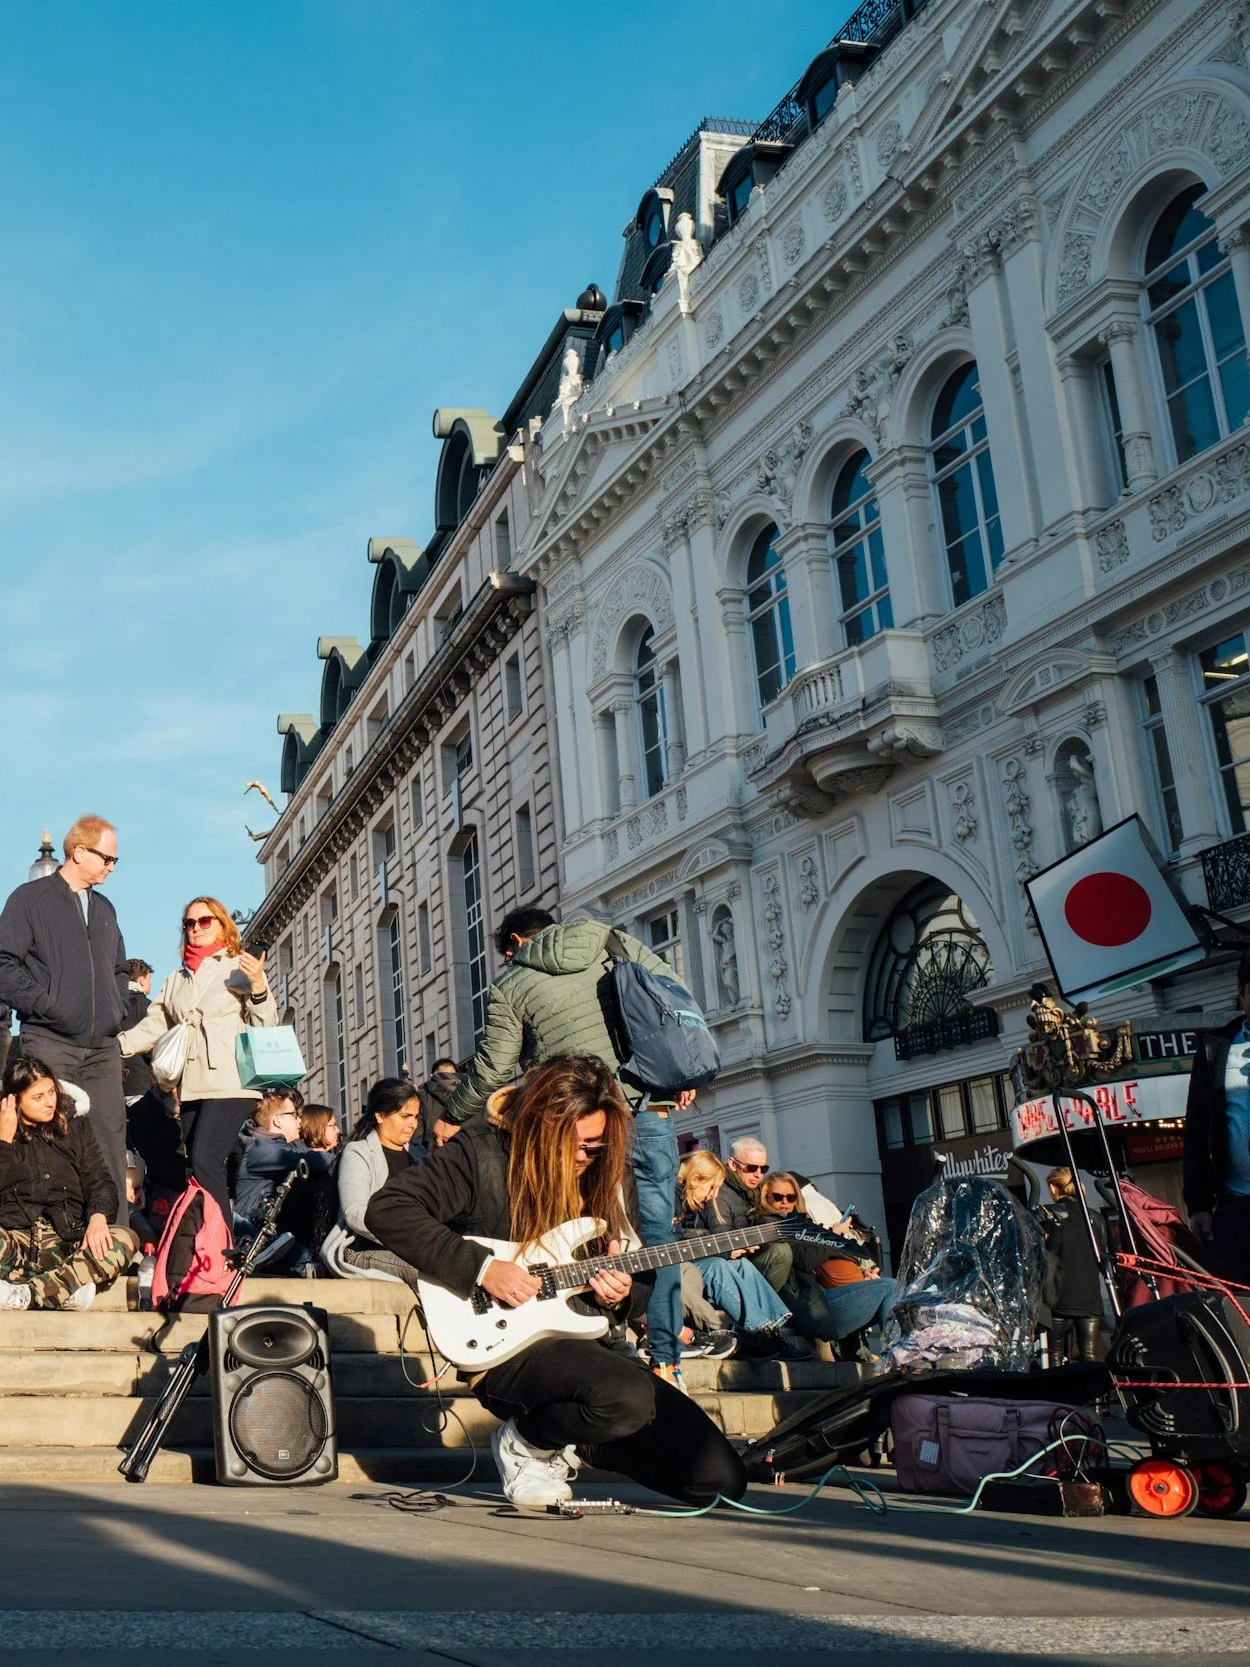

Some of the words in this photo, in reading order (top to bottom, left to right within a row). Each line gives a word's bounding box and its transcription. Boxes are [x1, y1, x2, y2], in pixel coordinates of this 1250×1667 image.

[1139, 1032, 1198, 1058] THE
[1154, 1142, 1179, 1151] BELIEVE
[934, 1145, 1011, 1182] illywhites
[795, 1229, 844, 1248] Jackson
